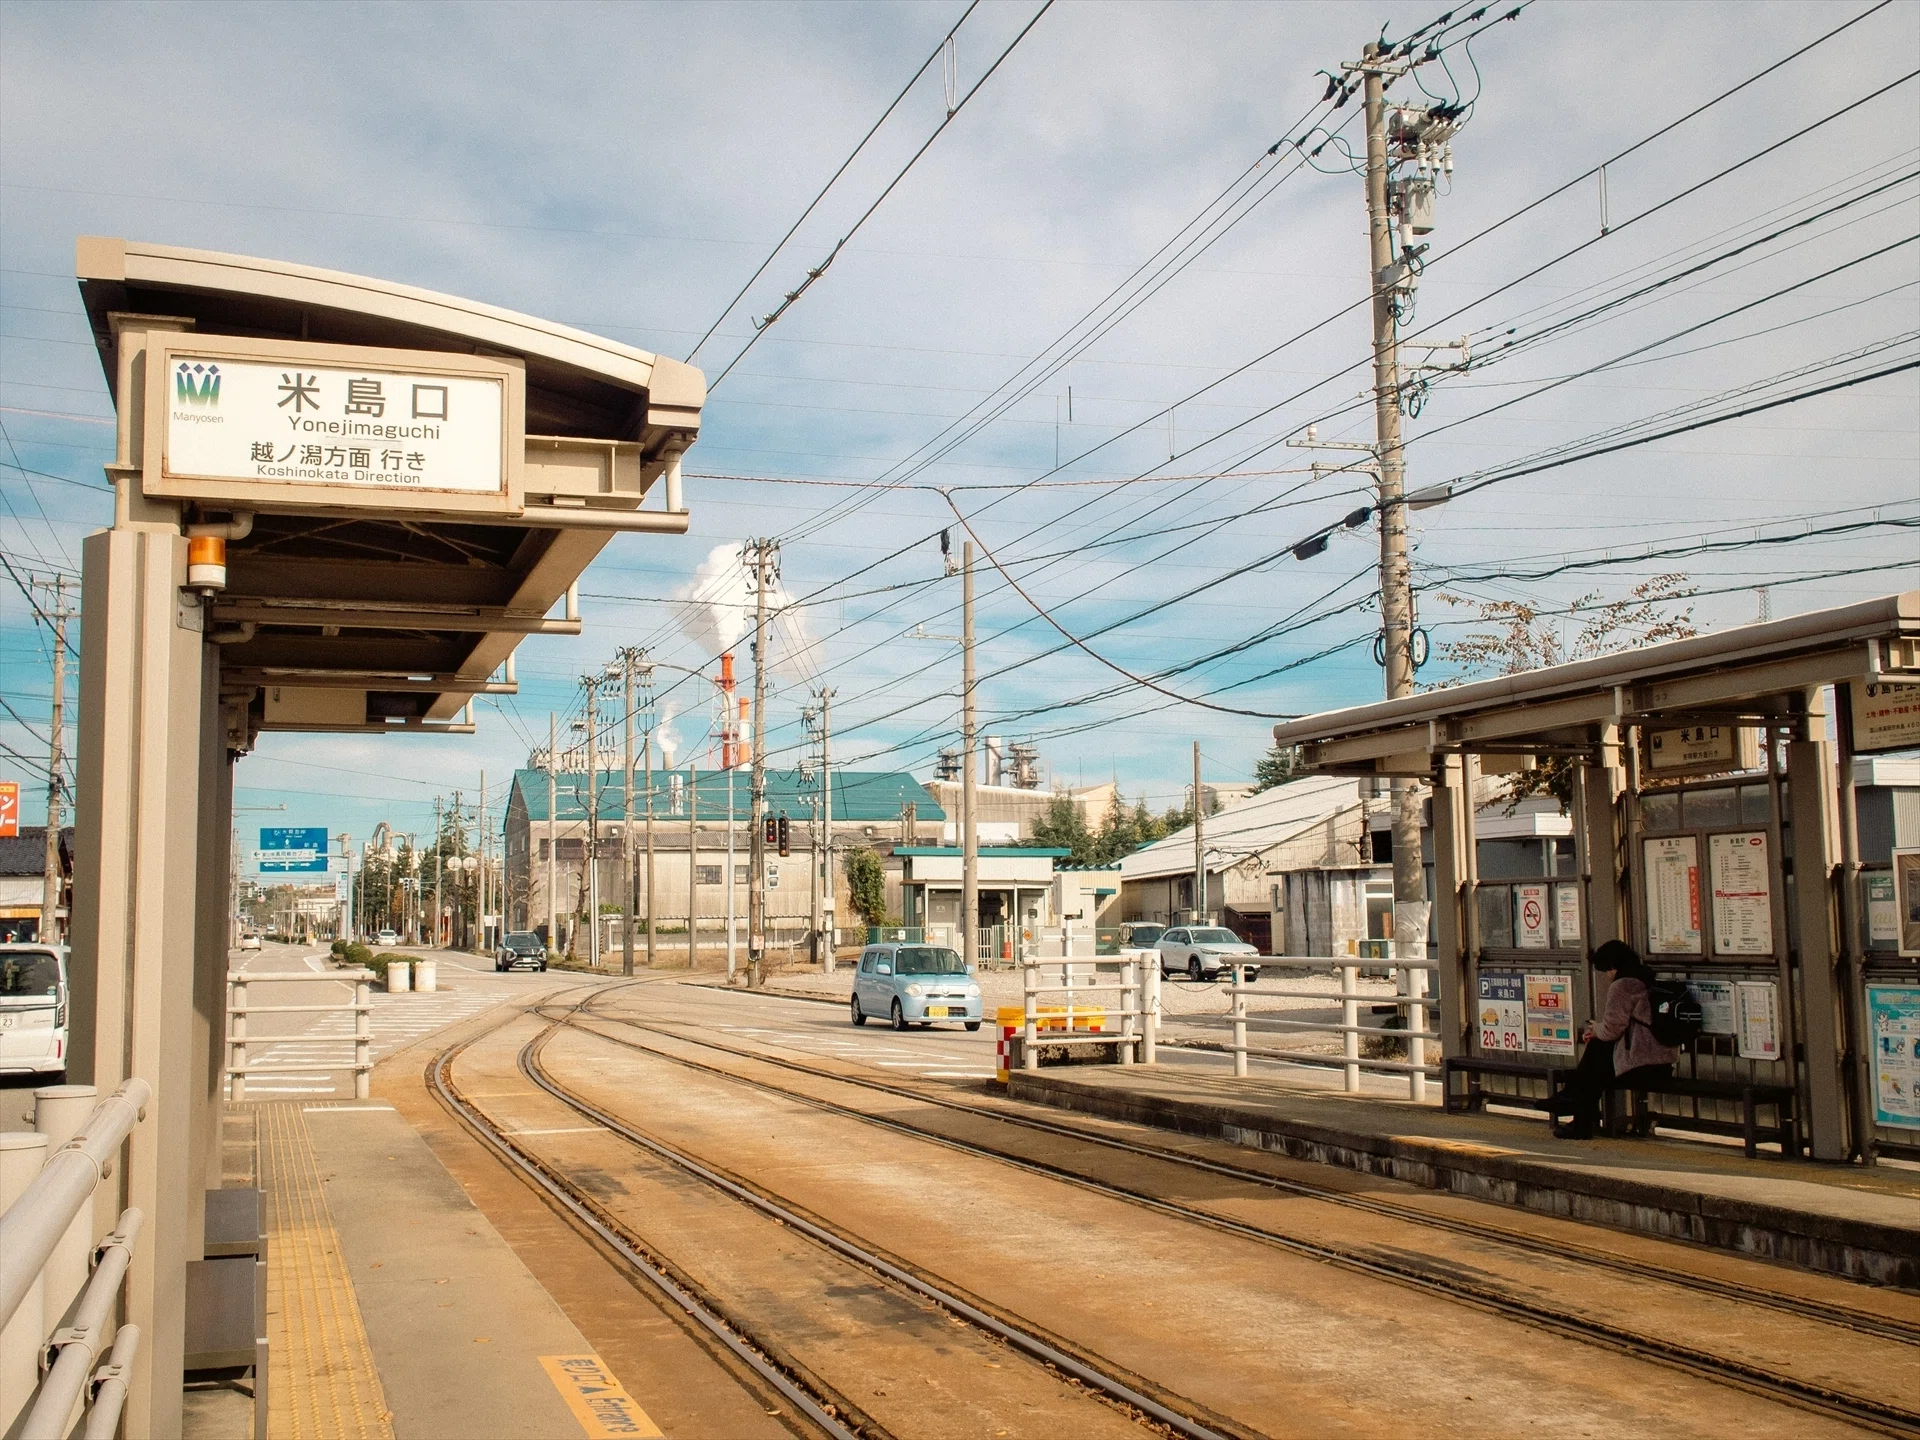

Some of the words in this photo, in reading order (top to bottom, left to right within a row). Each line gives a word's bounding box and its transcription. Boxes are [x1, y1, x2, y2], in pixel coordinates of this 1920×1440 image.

[277, 373, 449, 421] 米島口
[173, 411, 224, 424] Manyosen
[288, 415, 441, 440] Yonejimaguchi
[257, 464, 349, 481] Koshinokata
[354, 469, 421, 484] Direction
[1680, 726, 1719, 743] 米島口
